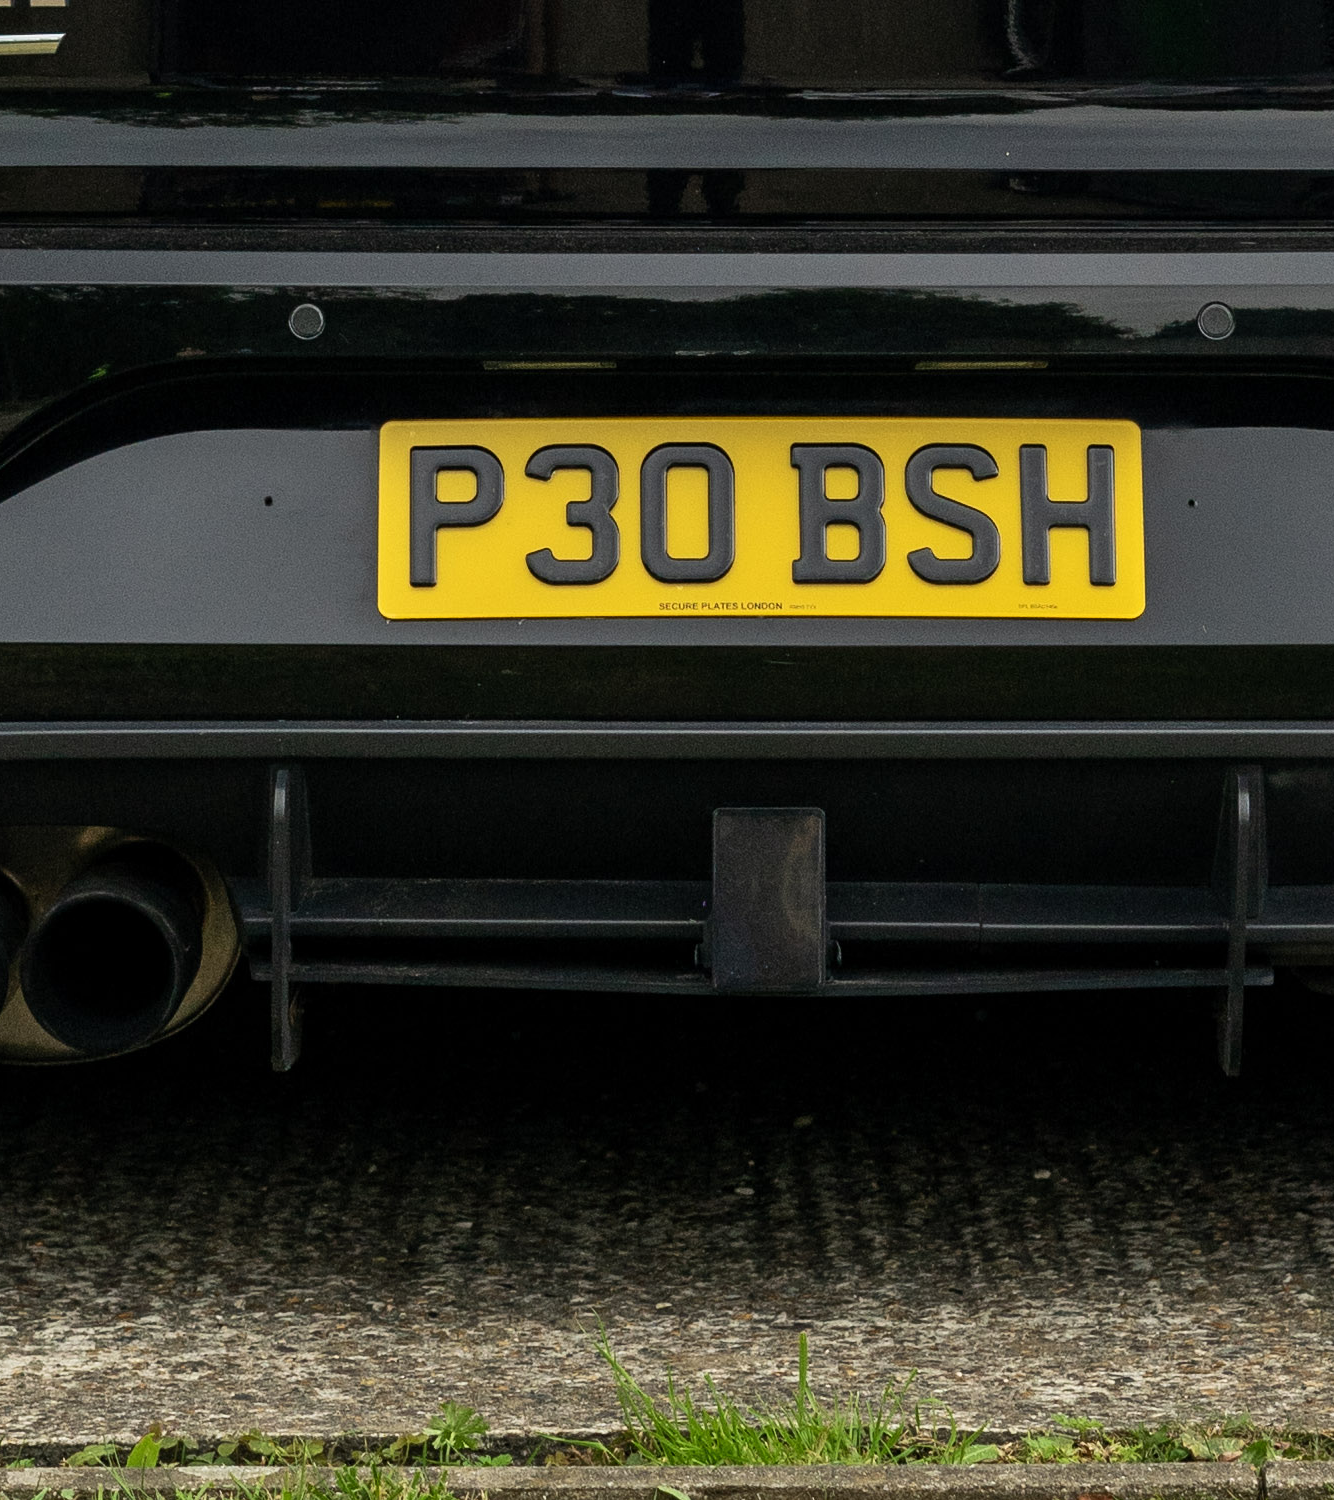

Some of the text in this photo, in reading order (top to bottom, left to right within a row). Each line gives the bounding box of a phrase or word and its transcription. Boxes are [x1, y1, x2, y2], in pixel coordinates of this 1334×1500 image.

[409, 441, 1117, 588] P30 BSH
[658, 602, 698, 611] SECURE
[701, 602, 738, 611] PLATES
[741, 602, 783, 610] LONDON
